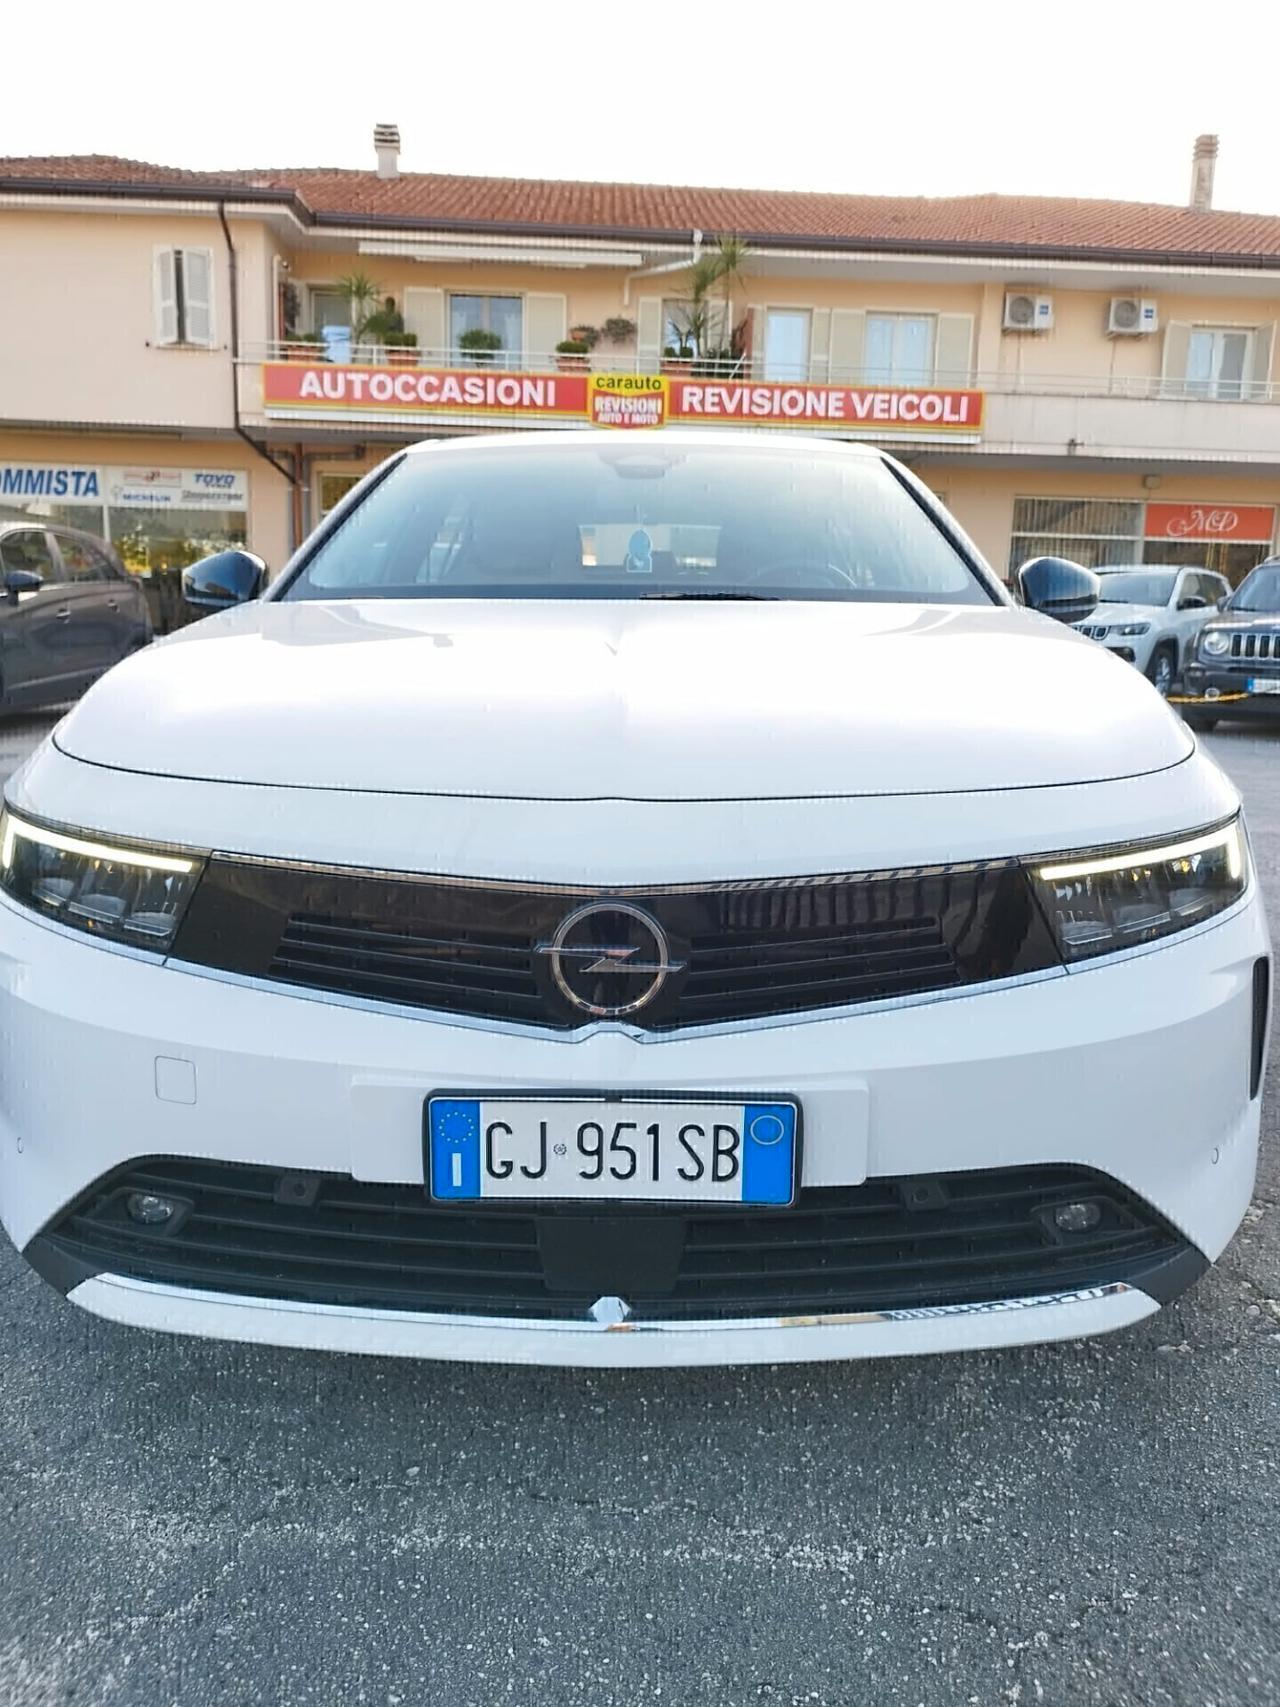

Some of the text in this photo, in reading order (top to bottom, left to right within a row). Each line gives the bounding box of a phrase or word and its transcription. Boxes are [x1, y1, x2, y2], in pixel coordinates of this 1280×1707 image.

[300, 371, 556, 407] AUTOCCASIONI
[596, 376, 662, 390] carauto
[595, 396, 663, 414] REVISIONI
[682, 386, 968, 422] REVISIONE VEICOLI
[598, 413, 622, 423] AUTO
[0, 468, 99, 496] MMISTA
[194, 473, 236, 485] TOYO
[485, 1121, 740, 1183] GJ 951 SB
